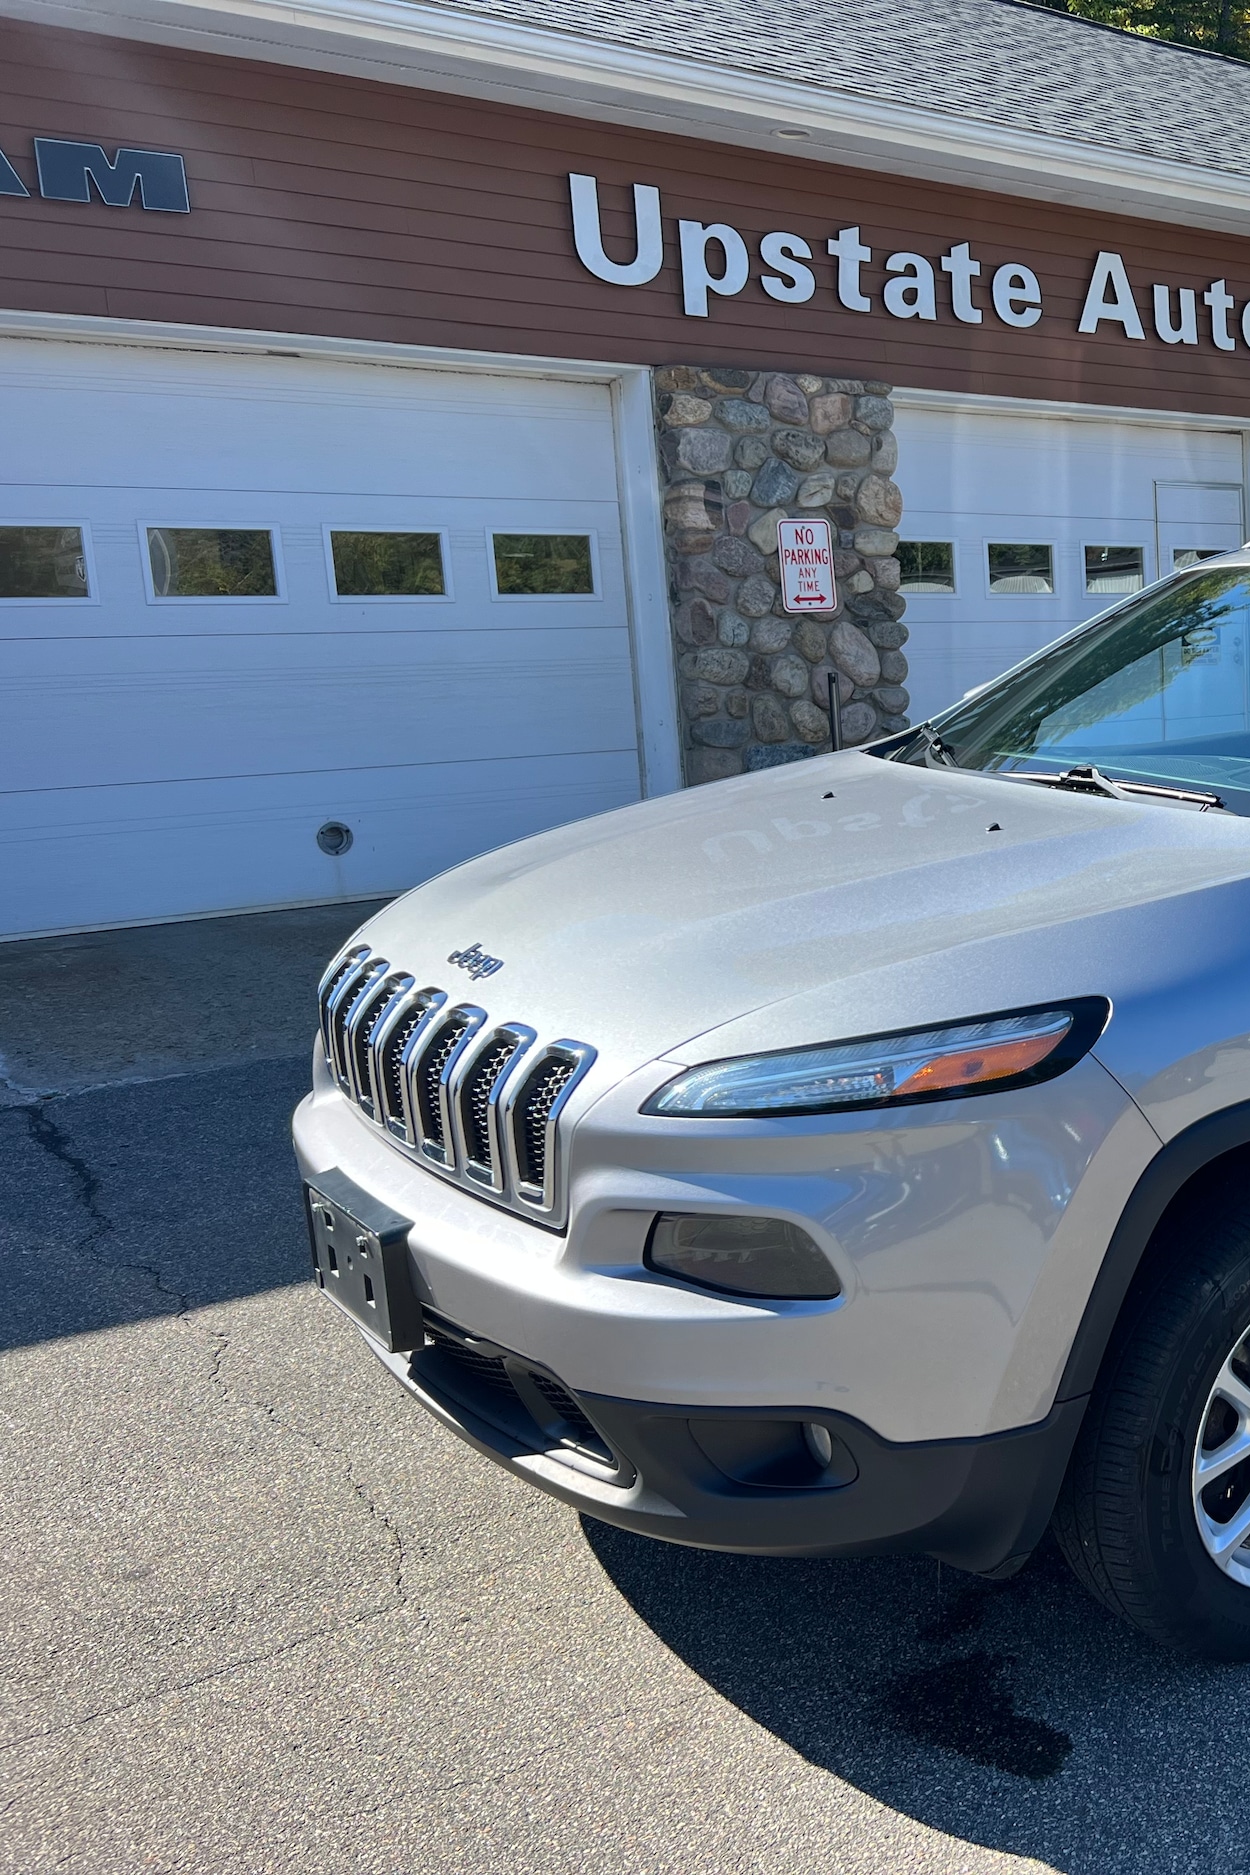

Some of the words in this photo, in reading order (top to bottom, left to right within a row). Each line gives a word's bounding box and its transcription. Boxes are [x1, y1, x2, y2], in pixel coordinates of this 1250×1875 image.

[568, 171, 1043, 329] Upstate
[794, 528, 814, 545] NO
[784, 548, 829, 565] PARKING
[798, 567, 817, 579] ANY
[797, 580, 820, 592] TIME
[446, 942, 505, 981] Jeep
